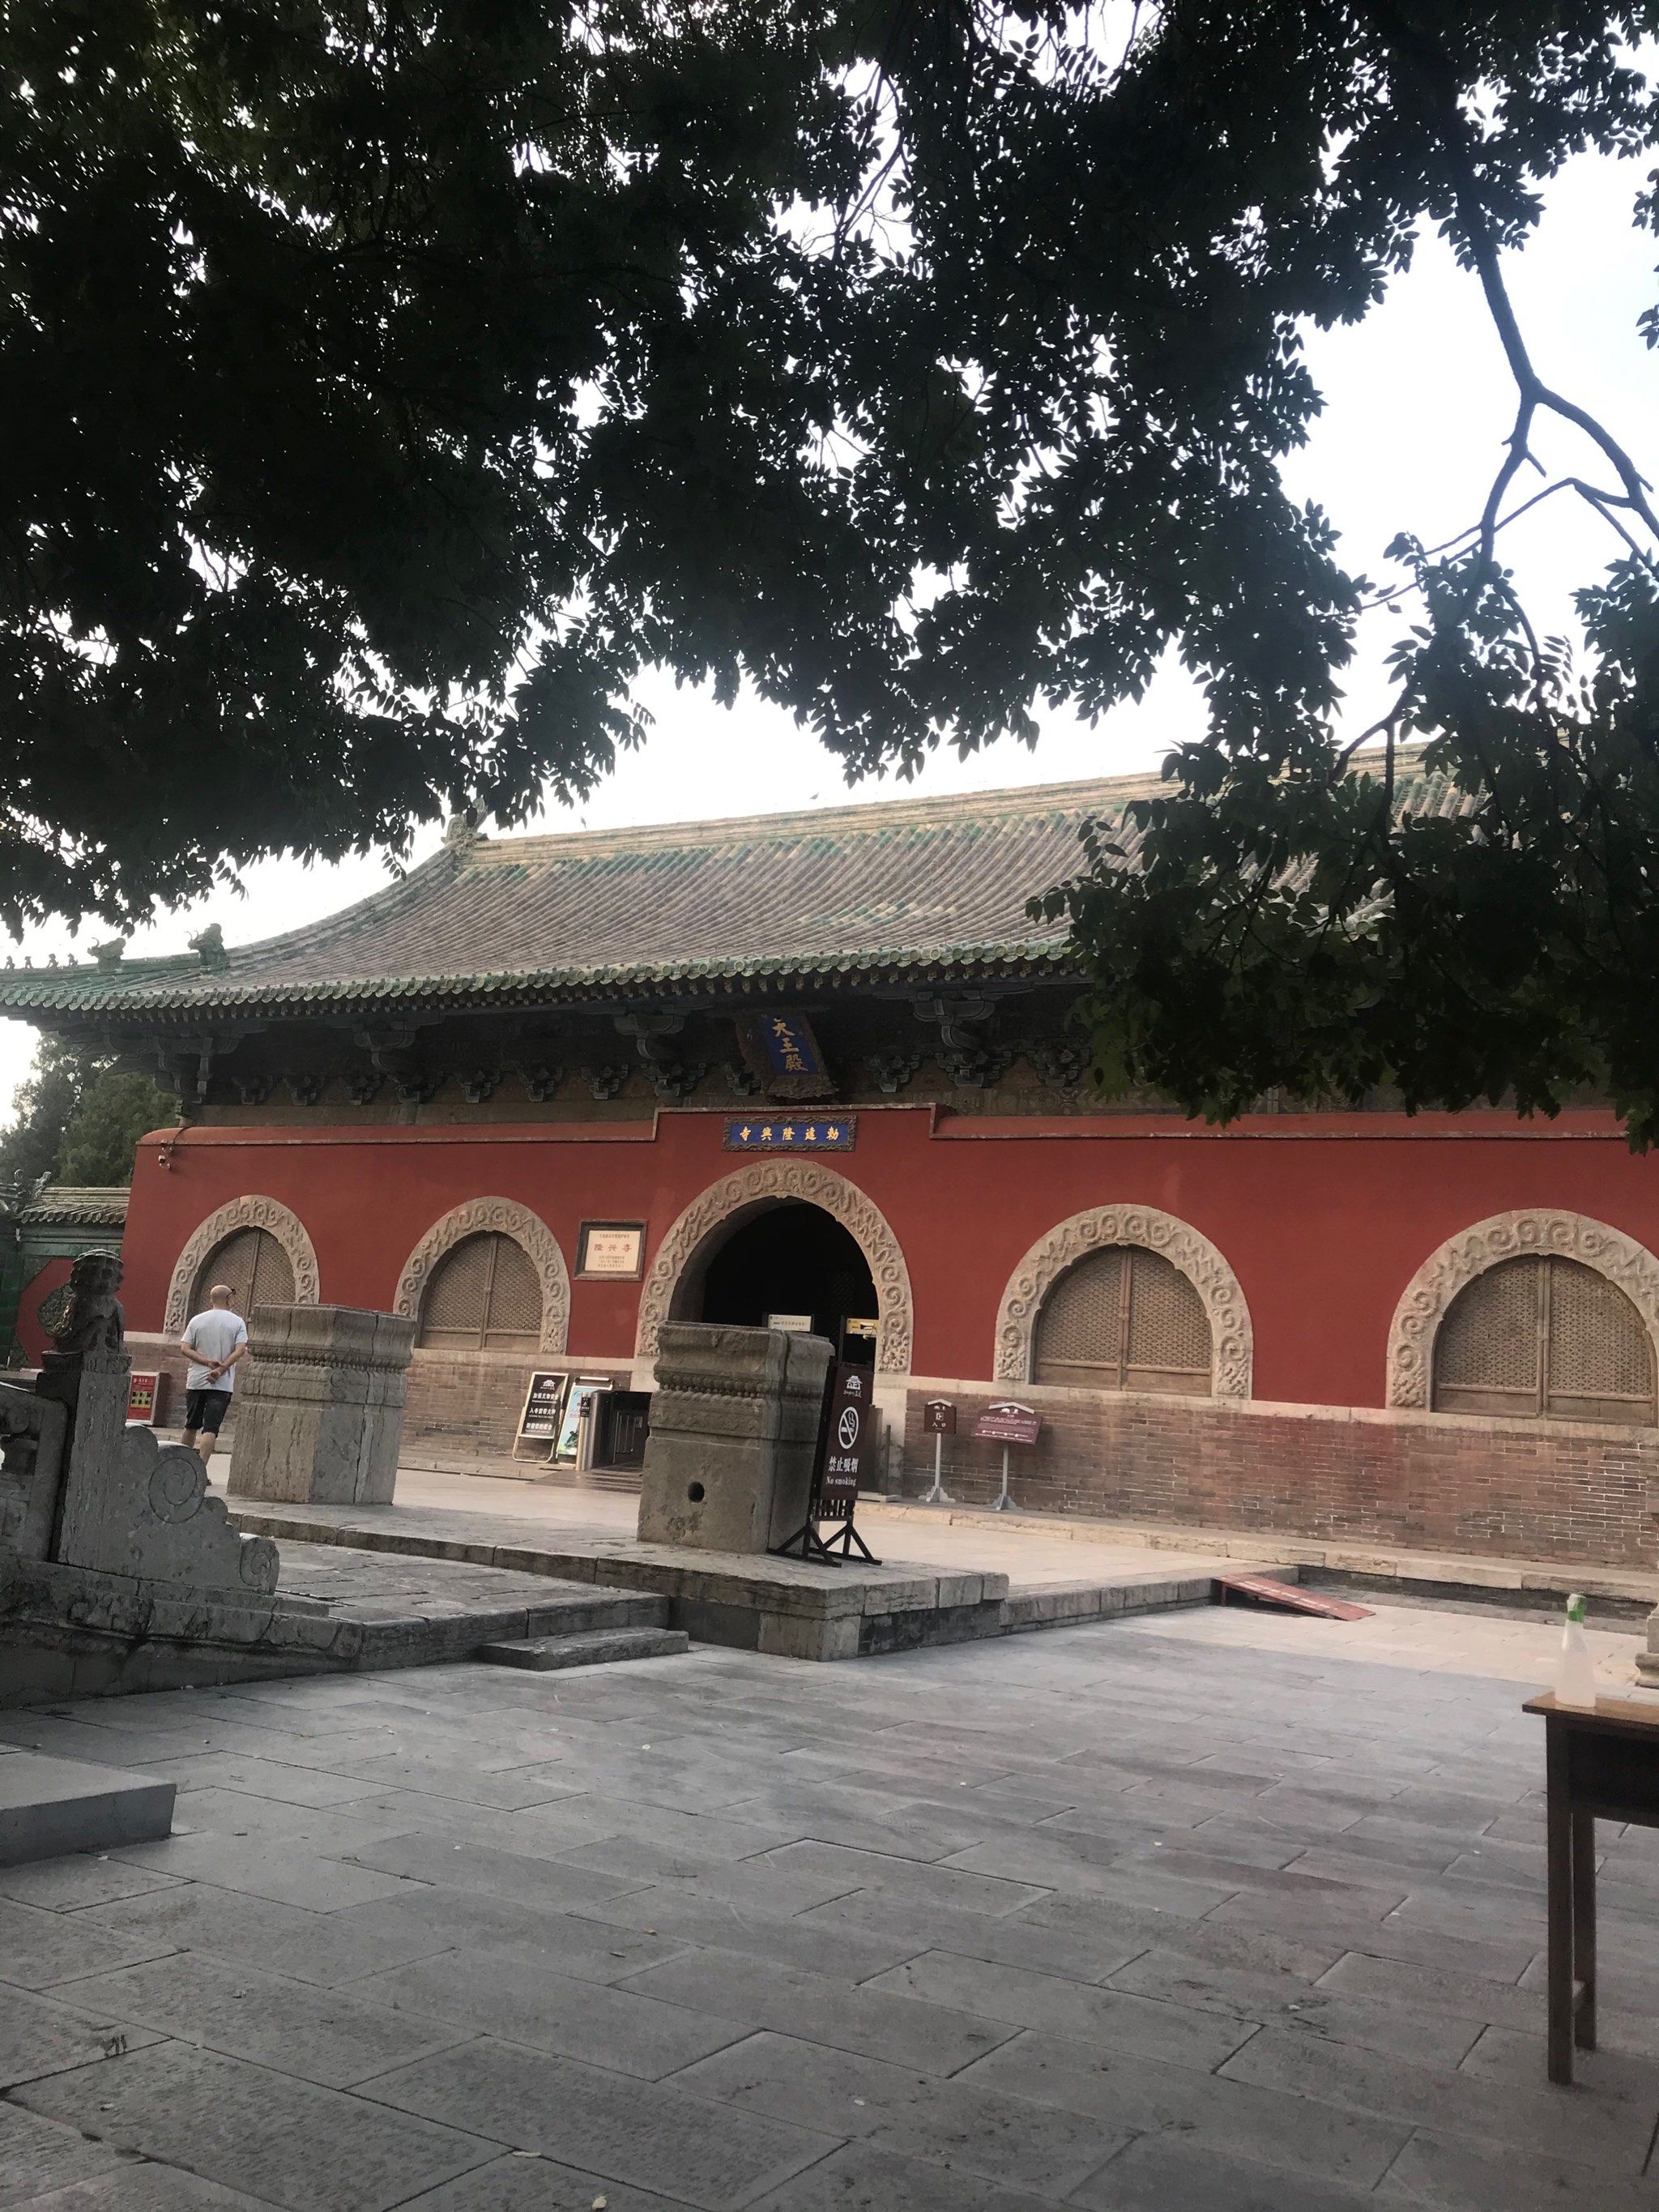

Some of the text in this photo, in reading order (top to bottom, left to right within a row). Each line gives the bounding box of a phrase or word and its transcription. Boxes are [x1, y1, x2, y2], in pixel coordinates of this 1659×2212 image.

[772, 1018, 809, 1072] 天王殿
[828, 1456, 859, 1473] 禁止吸烟
[825, 1475, 857, 1487] No smoking
